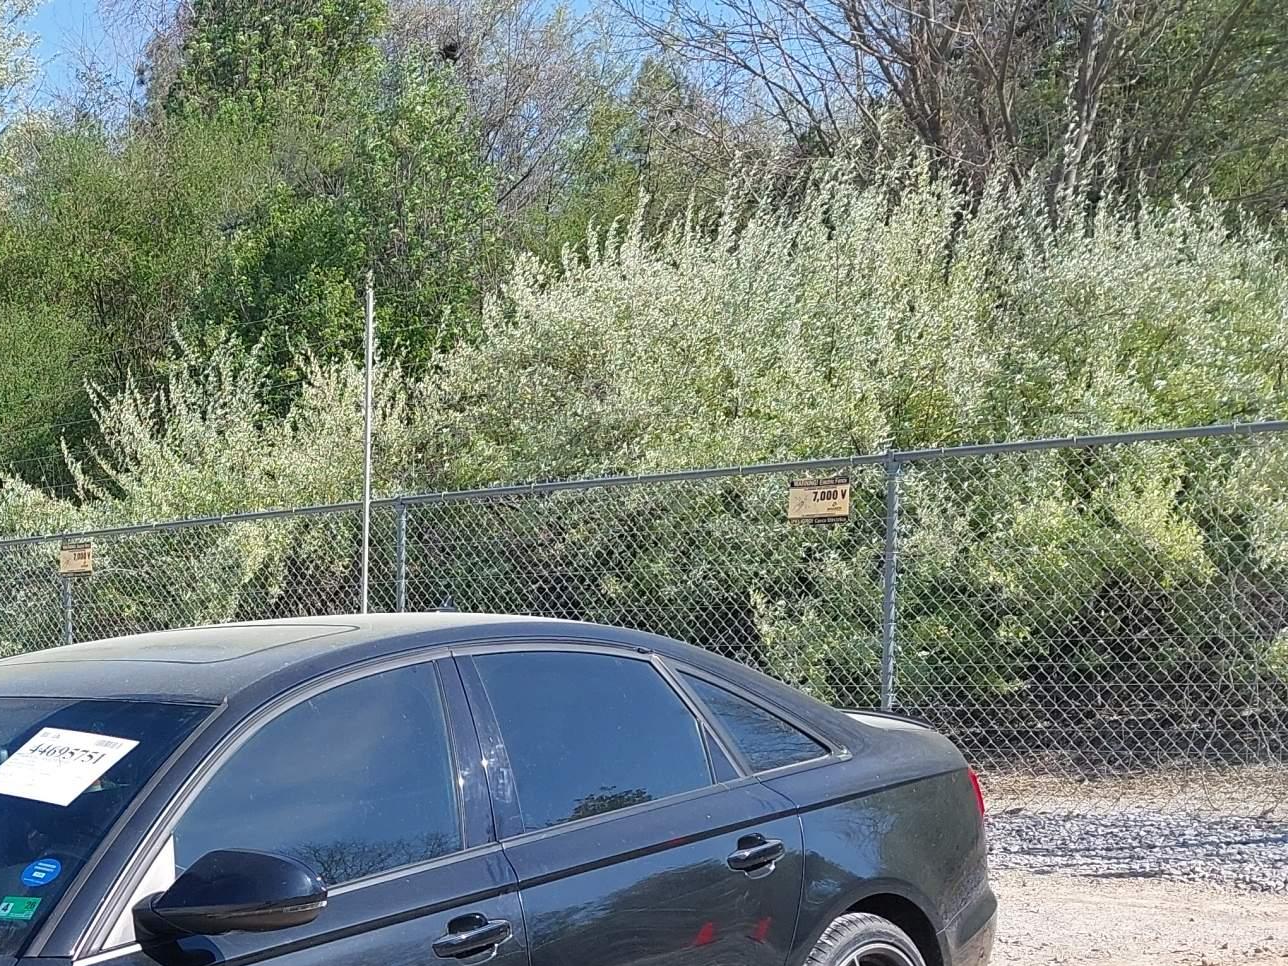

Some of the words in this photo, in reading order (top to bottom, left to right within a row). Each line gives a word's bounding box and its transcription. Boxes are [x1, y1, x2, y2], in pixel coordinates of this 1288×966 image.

[812, 489, 838, 503] 7,000
[840, 489, 847, 500] V
[29, 743, 107, 765] 44695751
[1, 903, 11, 912] 4
